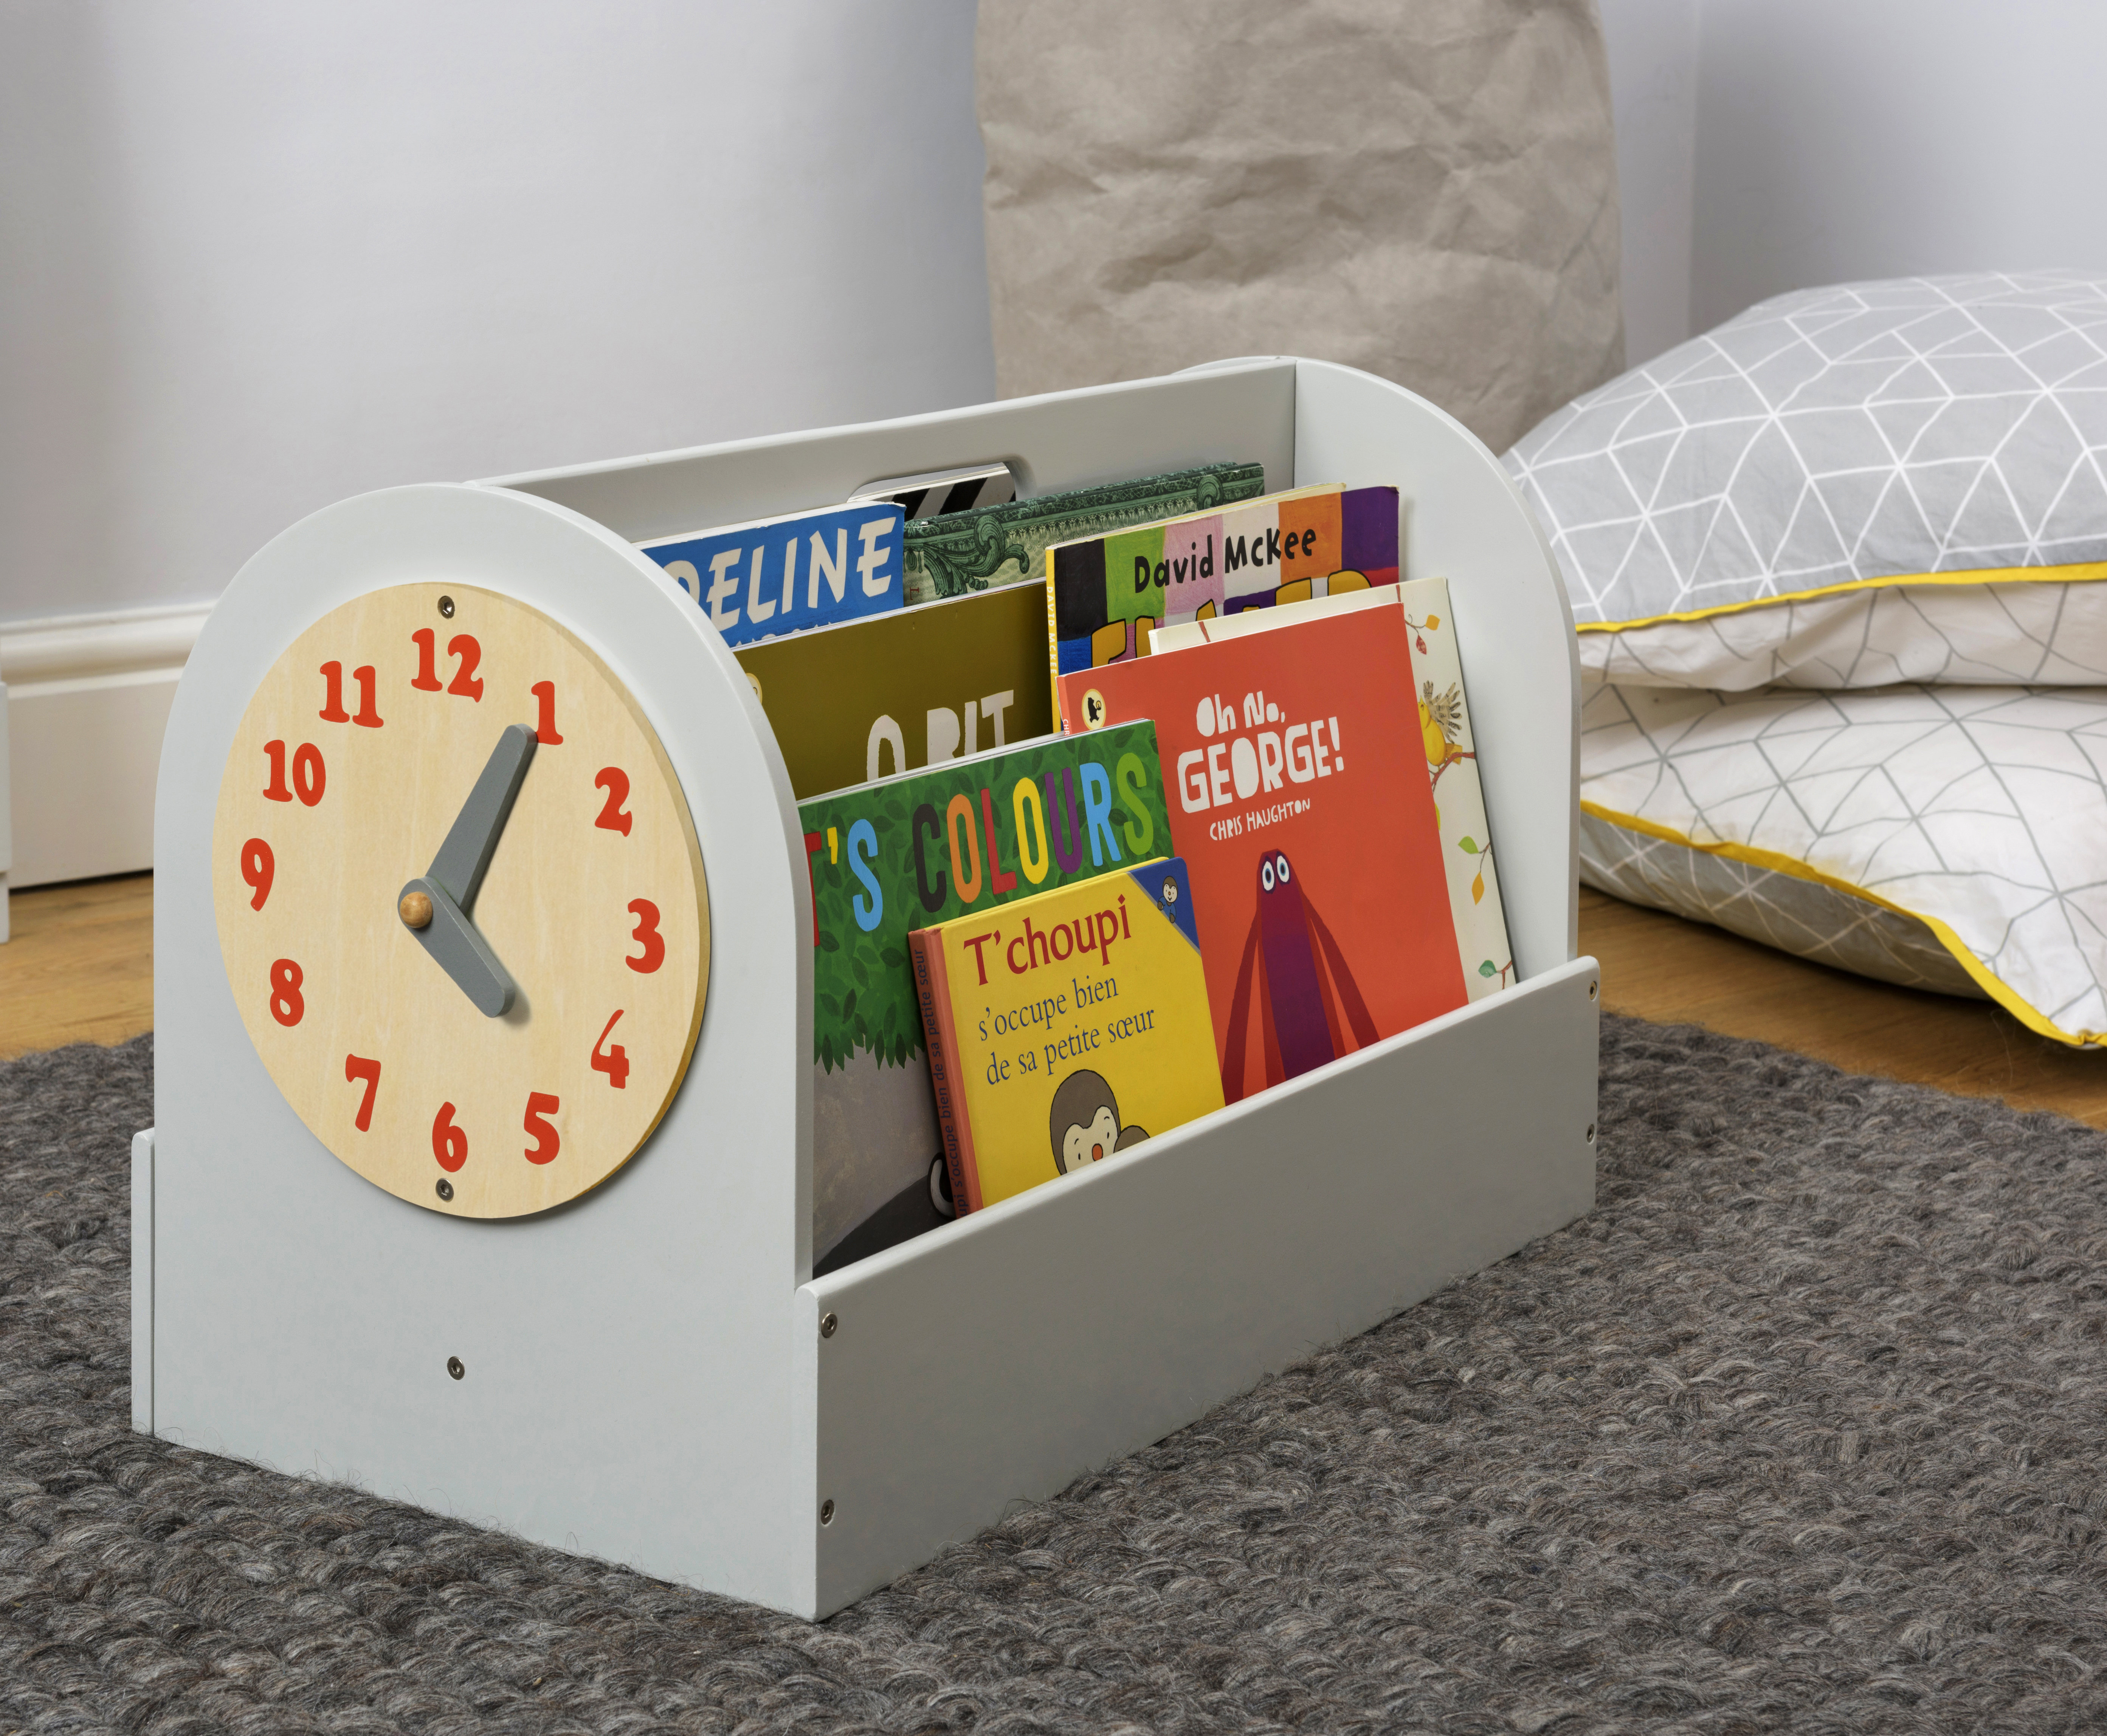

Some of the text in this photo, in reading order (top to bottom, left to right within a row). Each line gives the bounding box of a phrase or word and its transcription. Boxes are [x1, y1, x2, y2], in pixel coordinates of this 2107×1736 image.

[1135, 528, 1316, 593] David McKee
[411, 627, 484, 703] 12
[1049, 632, 1057, 674] MCKEE
[319, 661, 384, 728] 11
[530, 680, 564, 745] 1
[1196, 691, 1285, 737] Oh No,
[263, 739, 326, 807] 10
[1177, 716, 1344, 814] GEORGE!
[594, 767, 633, 837] 2
[912, 752, 1154, 913] COLOURS
[1210, 798, 1310, 841] CHRIS HAUGHTON
[240, 838, 275, 911] 9
[625, 898, 665, 974] 3
[914, 949, 928, 985] sœur
[963, 894, 1132, 986] T'choupi
[270, 958, 304, 1027] 8
[921, 992, 940, 1035] petite
[978, 975, 1119, 1041] s'occupe bien
[590, 1009, 629, 1089] 4
[930, 1042, 941, 1057] sa
[933, 1064, 945, 1081] de
[986, 1009, 1155, 1085] de sa petite sœur
[345, 1054, 381, 1132] 7
[938, 1087, 951, 1118] bien
[432, 1101, 468, 1173] 6
[524, 1092, 560, 1165] 5
[944, 1125, 963, 1188] s'occupe
